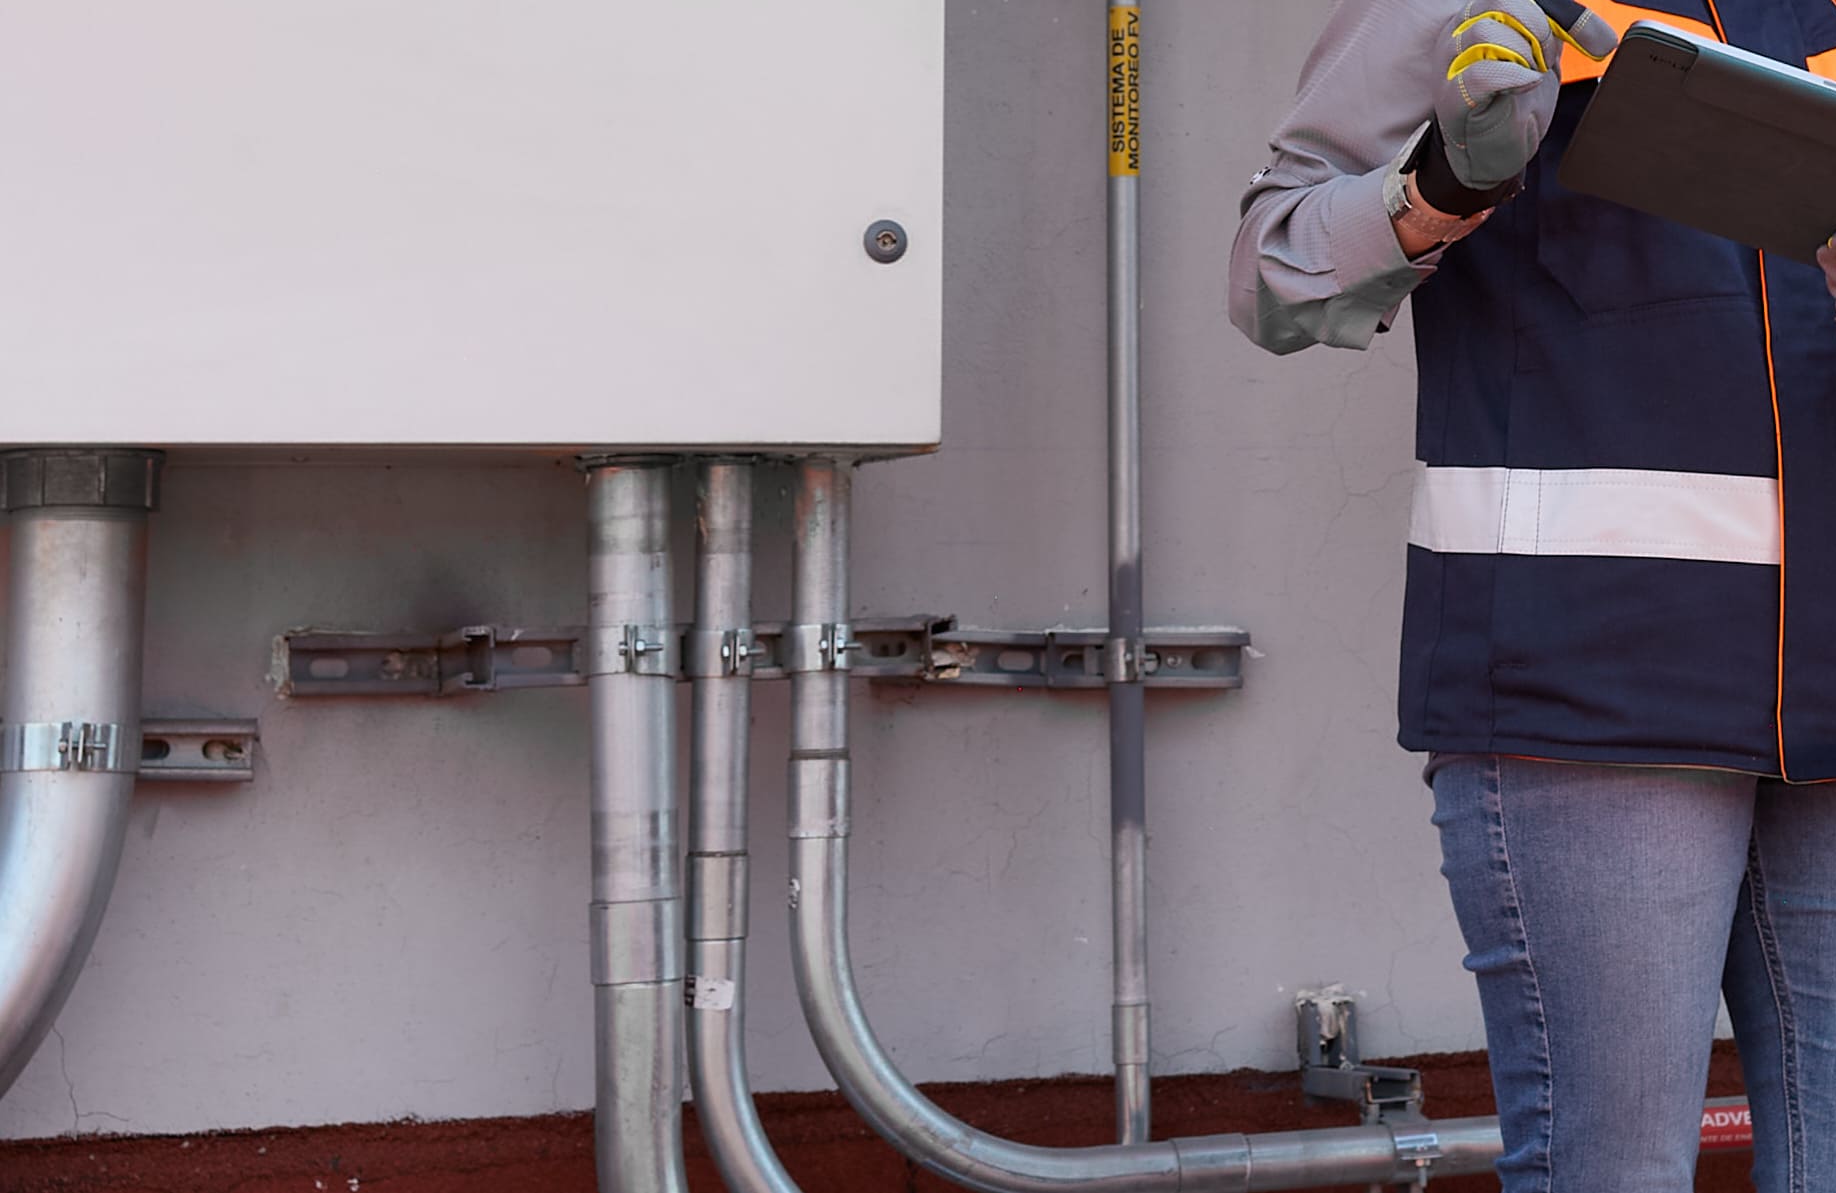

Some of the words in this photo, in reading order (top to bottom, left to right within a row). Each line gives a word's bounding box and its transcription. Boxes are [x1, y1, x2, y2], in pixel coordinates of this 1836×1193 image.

[1128, 11, 1139, 38] FV
[1112, 28, 1125, 56] DE
[1112, 61, 1125, 153] SISTEMA
[1128, 43, 1139, 169] MONITOREO
[1701, 1111, 1752, 1128] ADVE
